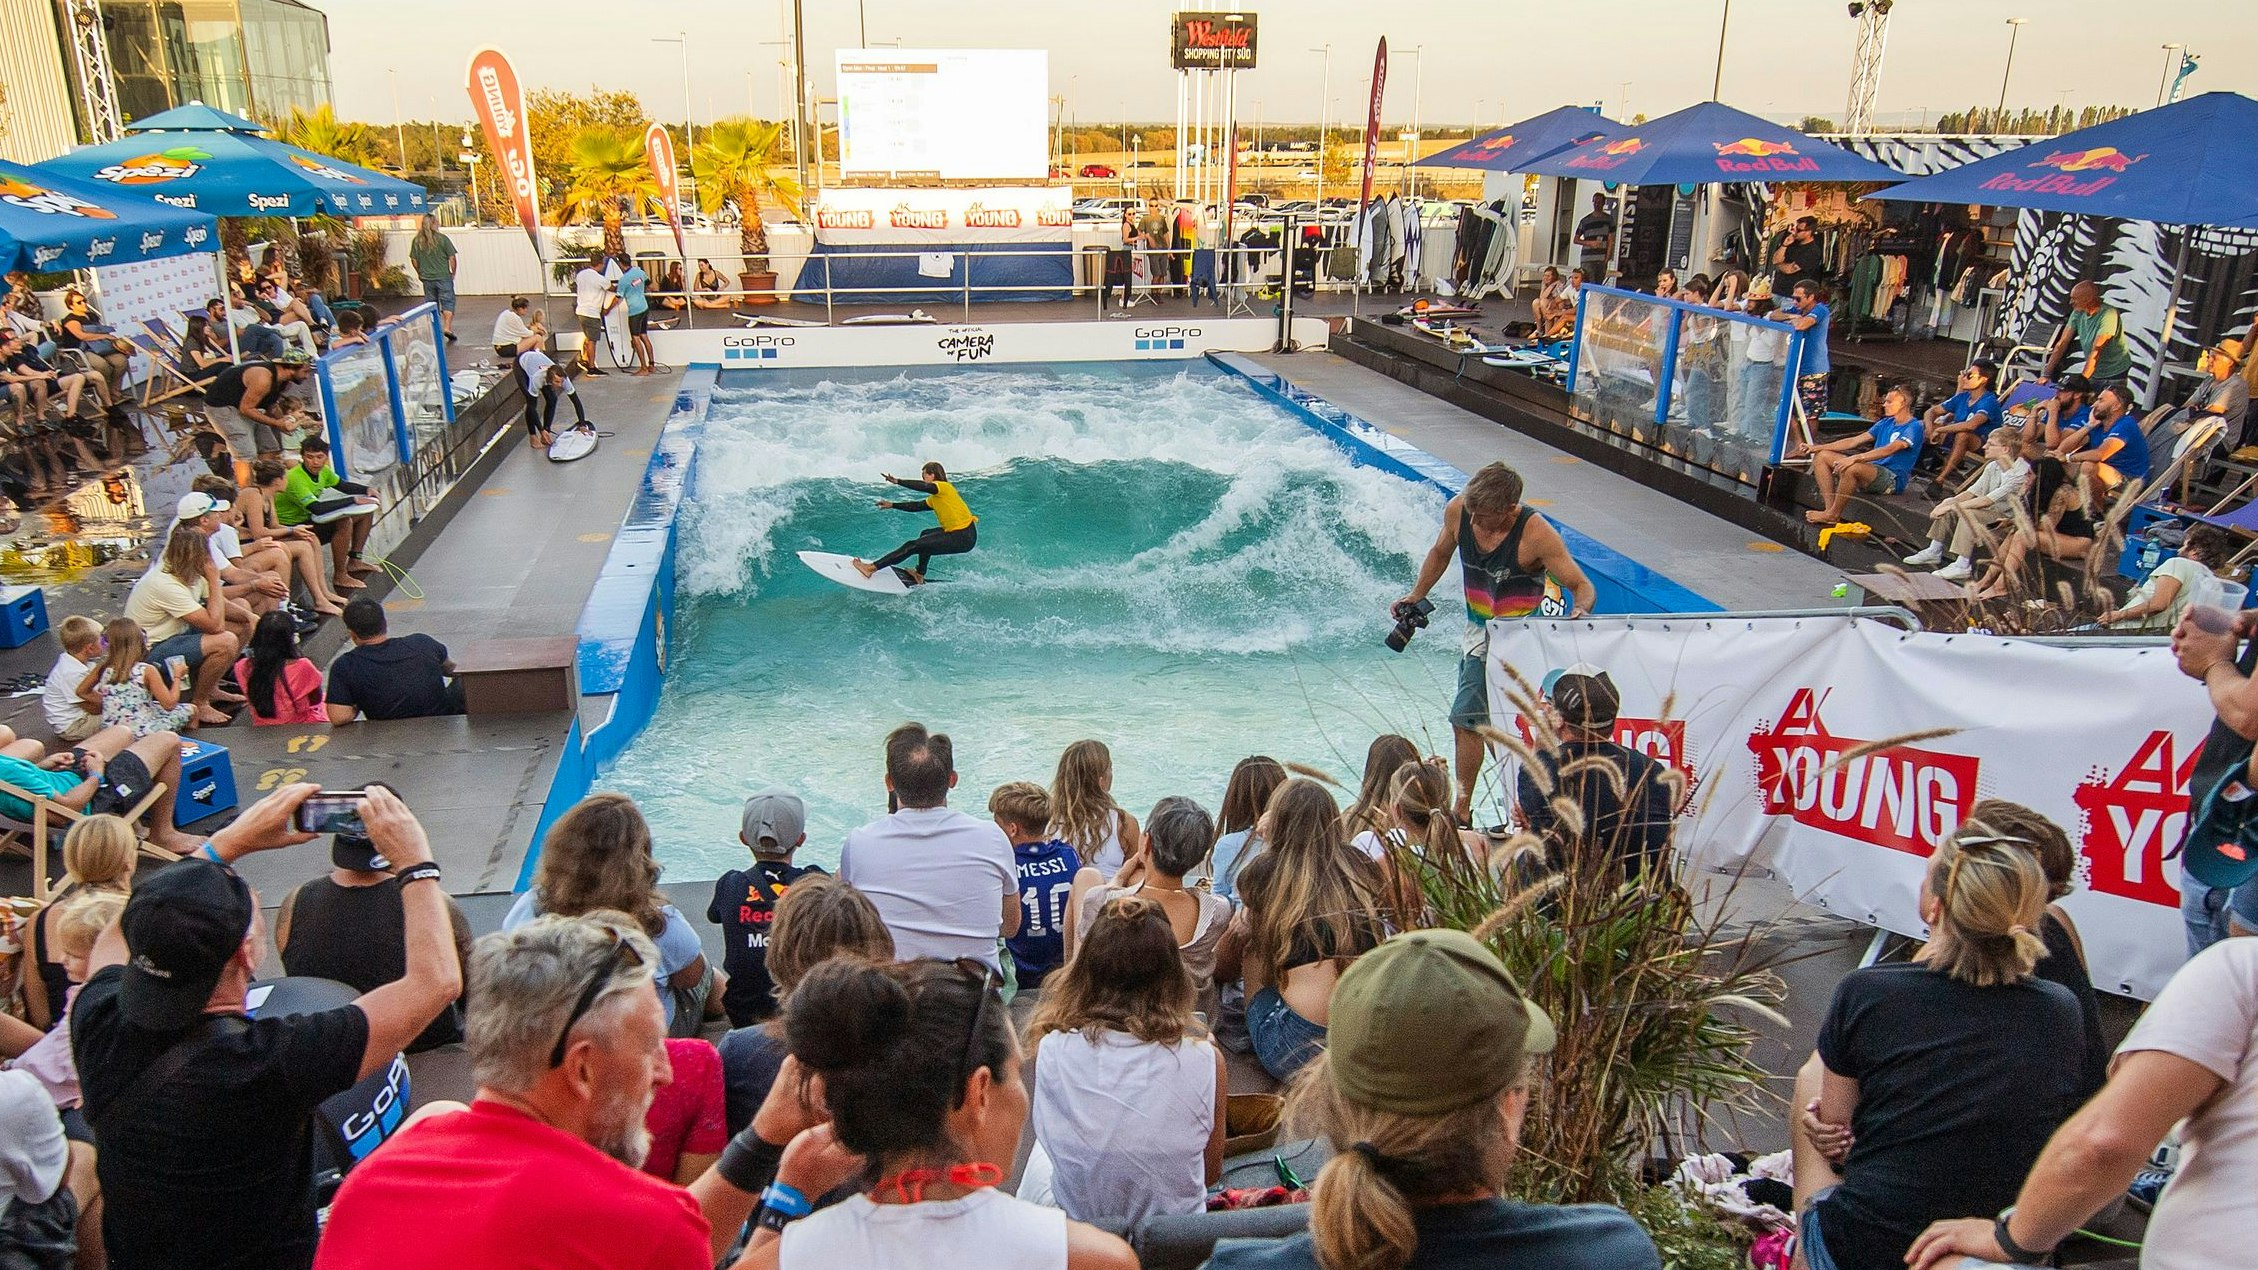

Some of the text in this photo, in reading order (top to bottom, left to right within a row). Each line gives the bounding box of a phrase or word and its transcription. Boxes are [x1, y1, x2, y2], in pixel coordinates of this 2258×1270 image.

[1186, 20, 1251, 47] Westfield
[1184, 47, 1220, 60] SHOPPING
[1716, 157, 1820, 172] Red Bull
[94, 164, 199, 183] Spezi
[1979, 173, 2118, 196] Red Bull
[248, 193, 289, 212] Spezi
[819, 211, 870, 227] YOUNG
[892, 211, 944, 227] YOUNG
[967, 210, 1018, 227] YOUNG
[1135, 326, 1202, 338] GoPro
[723, 336, 795, 347] GoPro
[937, 334, 994, 349] CAMERA
[957, 345, 991, 362] FUN
[1772, 746, 1959, 847] YOUNG
[1016, 857, 1068, 879] MESSI
[1021, 882, 1073, 937] 10
